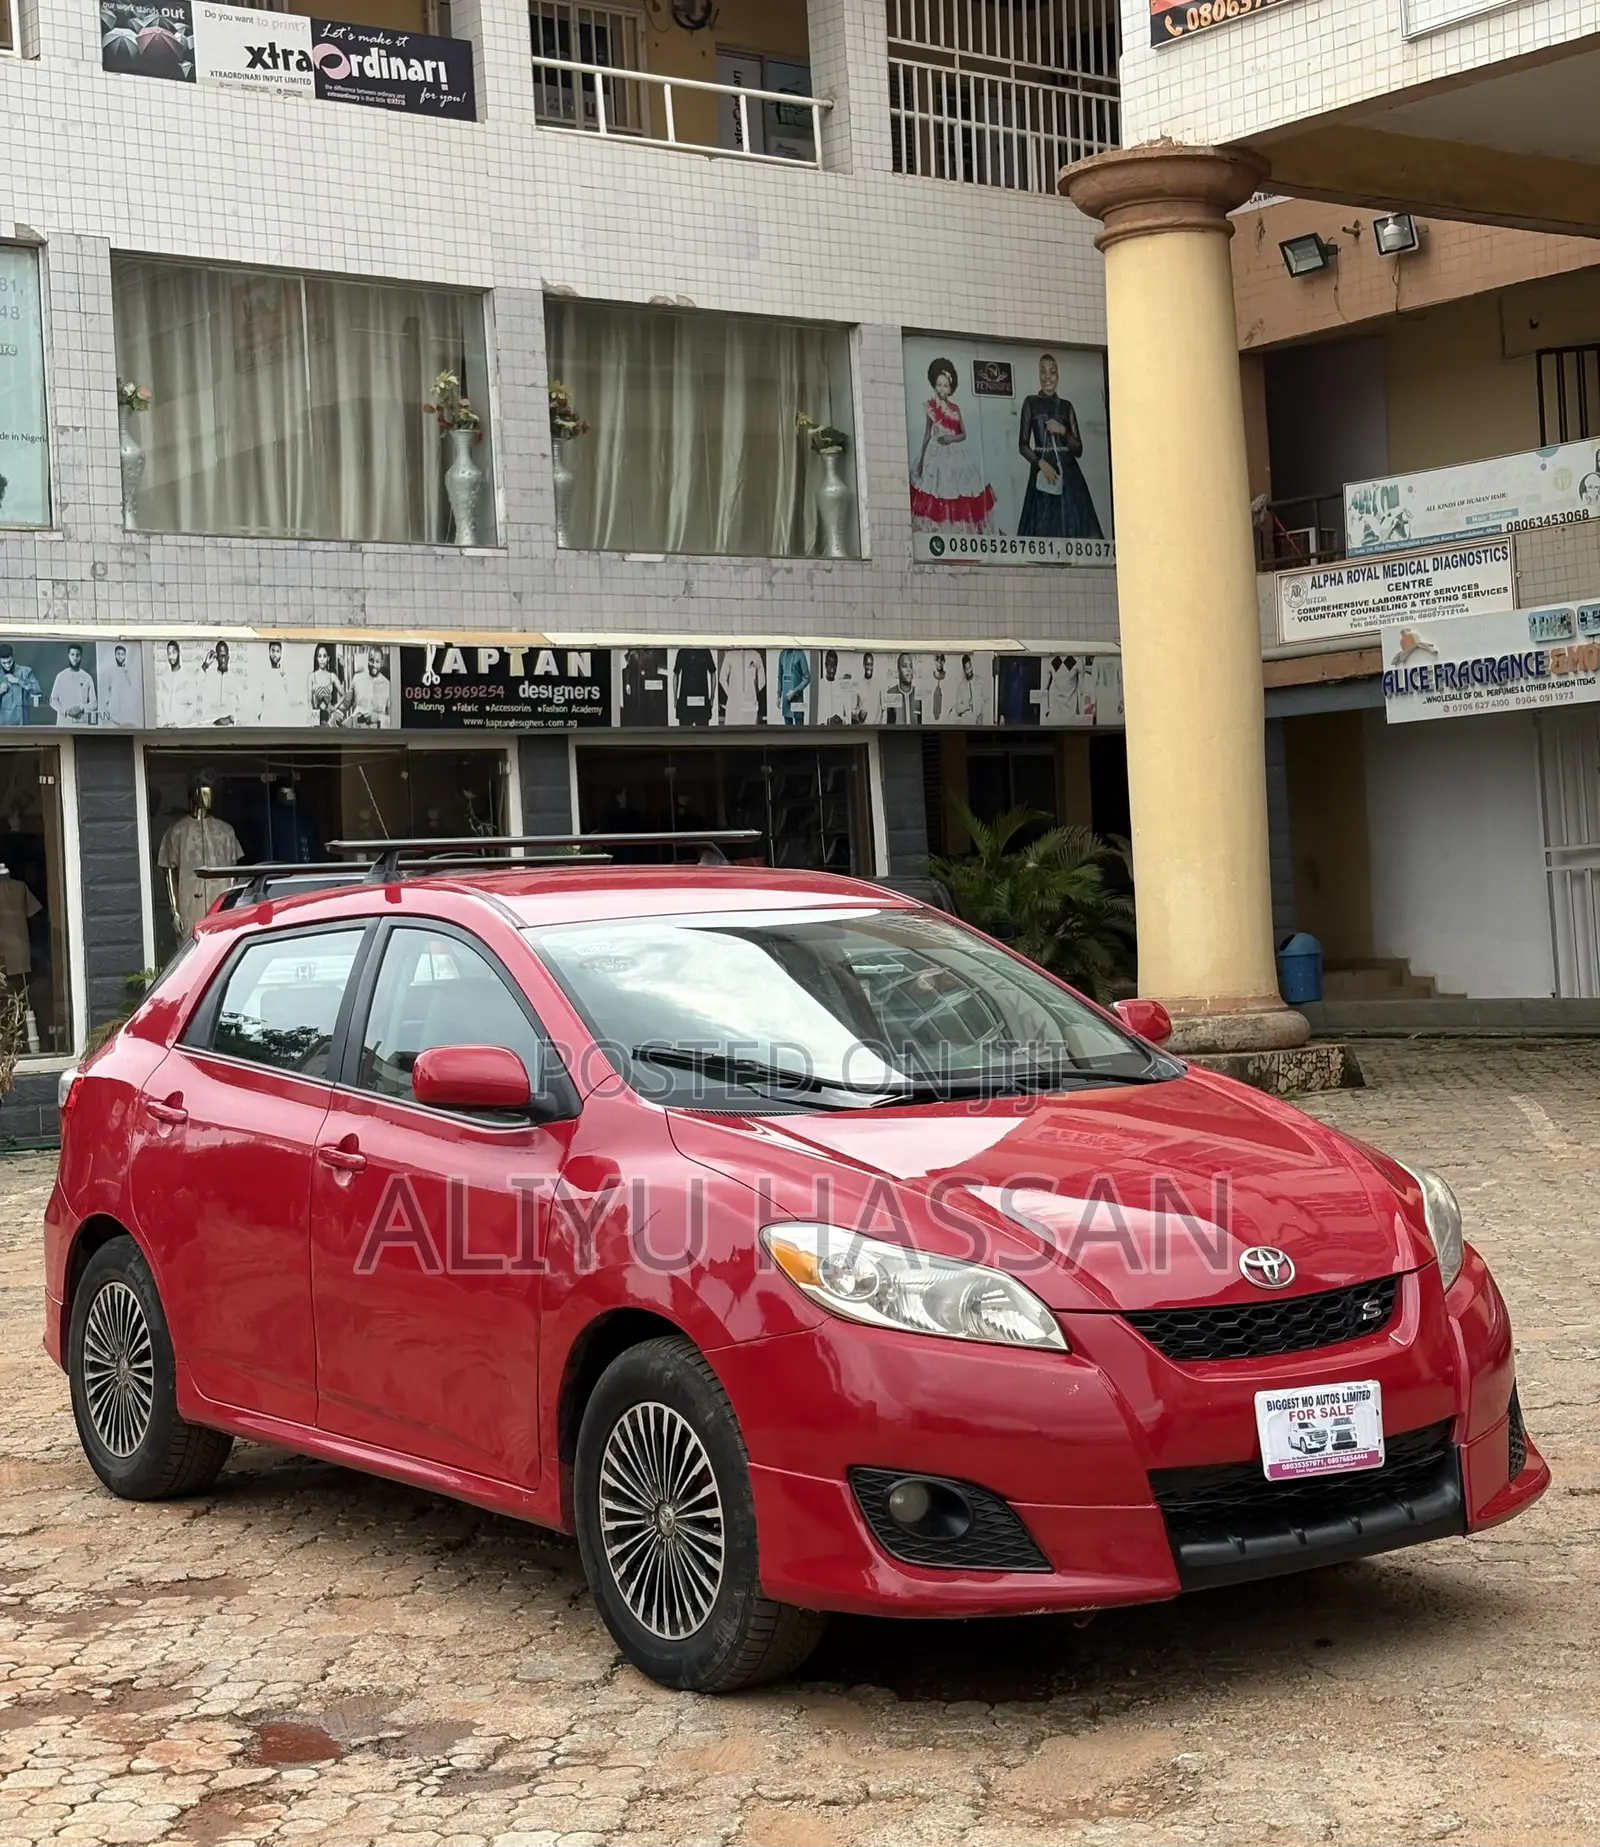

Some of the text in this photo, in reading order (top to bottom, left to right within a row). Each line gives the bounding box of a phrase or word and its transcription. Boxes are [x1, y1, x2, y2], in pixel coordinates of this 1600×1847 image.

[116, 3, 135, 12] work
[136, 5, 159, 15] stands
[161, 7, 185, 20] out
[204, 9, 306, 33] Do you want to print?
[320, 23, 410, 48] Let's make it
[209, 70, 312, 86] XTRAORDINARI INPUT LIMITED
[386, 98, 406, 106] extra
[419, 87, 467, 108] for you!
[11, 433, 20, 442] in
[1425, 504, 1437, 513] ALL
[1437, 501, 1457, 511] KINDS
[1466, 495, 1490, 505] HUMAN
[1506, 508, 1590, 533] 08063453068
[949, 537, 1061, 559] 08065267681,
[1310, 545, 1509, 590] ALPHA ROYAL MEDICAL DIAGNOSTICS
[1387, 577, 1433, 593] CENTRE
[1297, 582, 1480, 616] COMPREHENSIVE LABORATORY SERVICES
[1297, 586, 1509, 623] VOLUNTARY COUNSELING & TESTING SERVICES
[1383, 665, 1430, 697] ALICE
[1433, 651, 1546, 691] FRAGRANCE
[518, 680, 601, 705] designers
[1463, 691, 1473, 701] OF
[1486, 685, 1520, 697] PERFUMES
[1520, 685, 1525, 693] &
[1525, 682, 1547, 693] OTHER
[1547, 679, 1577, 690] FASHION
[1576, 676, 1597, 687] ITEMS
[412, 701, 603, 716] Tailoring Fabric Accessories Fashion Academy
[1266, 1389, 1371, 1412] BIGGEST MO AUTOS LIMITED
[1288, 1404, 1354, 1423] FOR SALE
